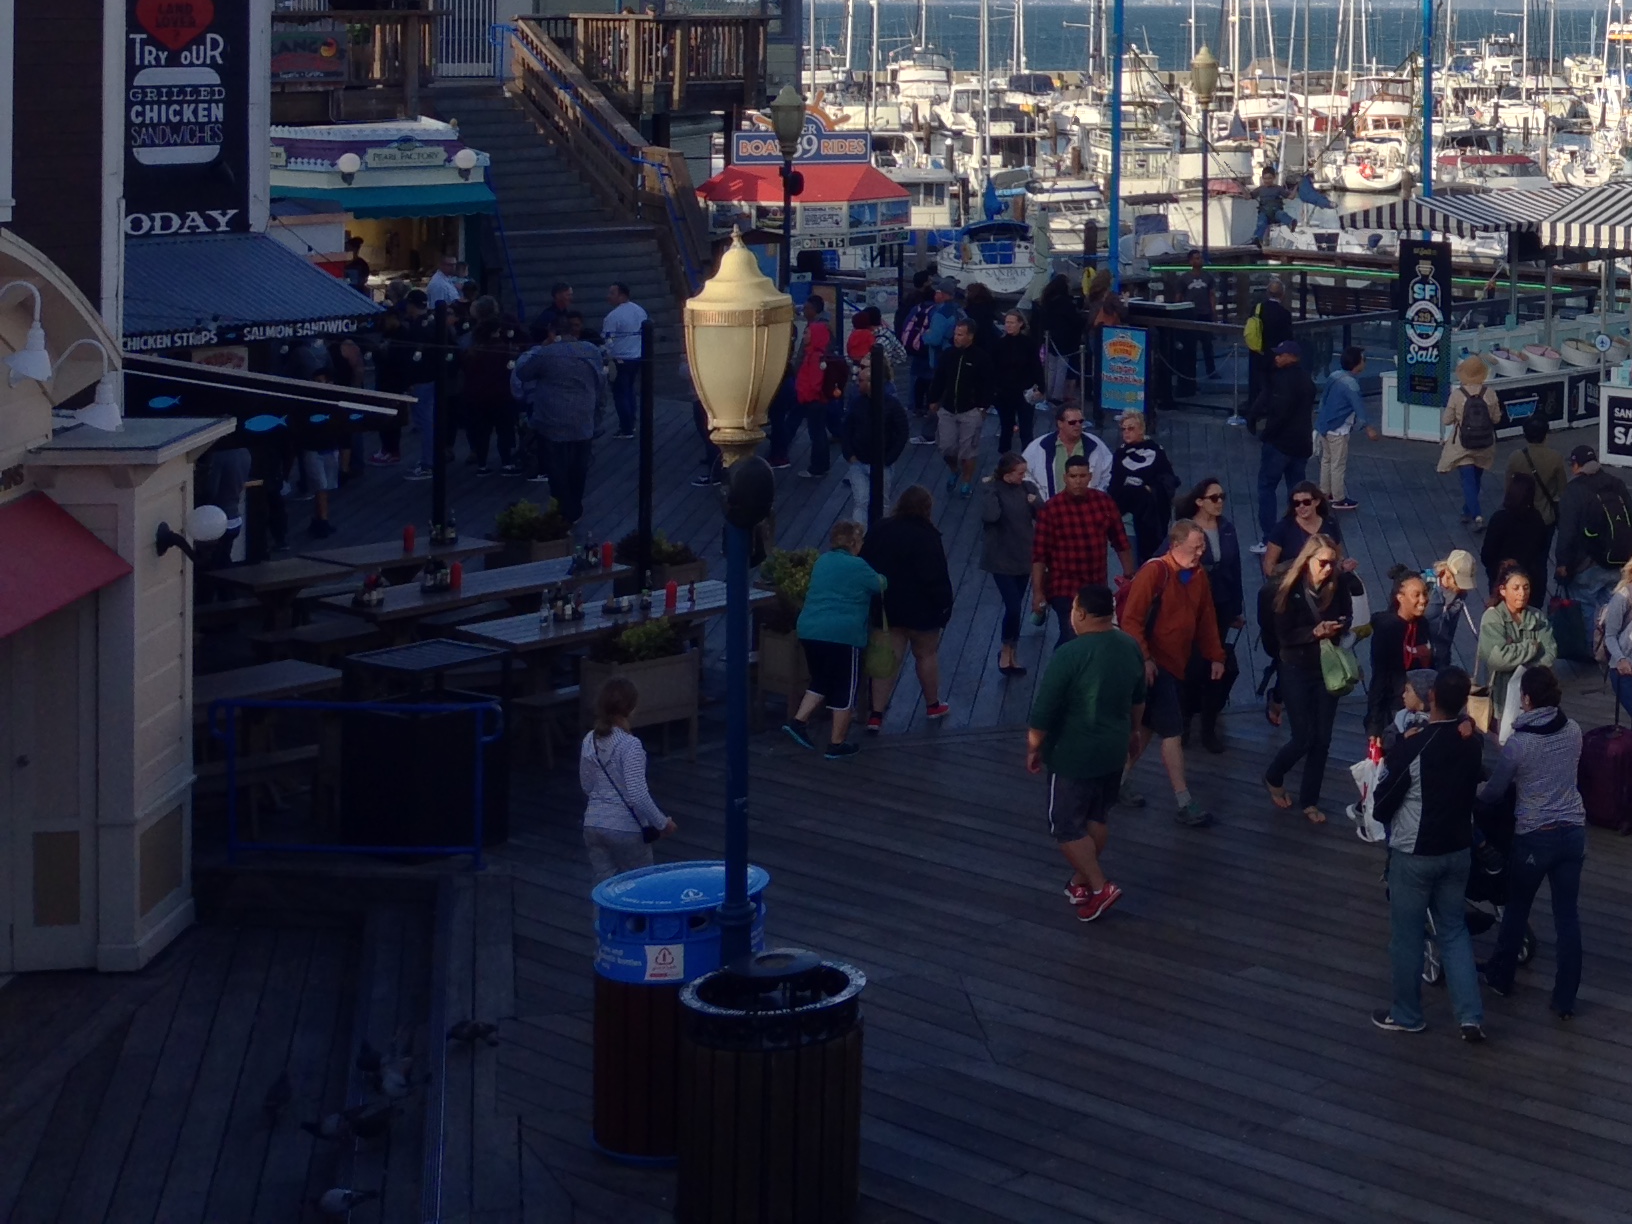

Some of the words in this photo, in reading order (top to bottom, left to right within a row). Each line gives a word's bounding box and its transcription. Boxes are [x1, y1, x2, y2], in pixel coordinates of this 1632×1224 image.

[130, 86, 226, 102] GRILLED
[131, 103, 224, 125] CHICKEN
[131, 124, 224, 146] SANDWICHES
[820, 139, 866, 155] RIDES
[124, 208, 240, 235] ODAY
[1413, 282, 1437, 300] SF
[122, 332, 172, 352] CHICKEN
[243, 325, 294, 341] SALMON
[1406, 343, 1440, 364] Salt
